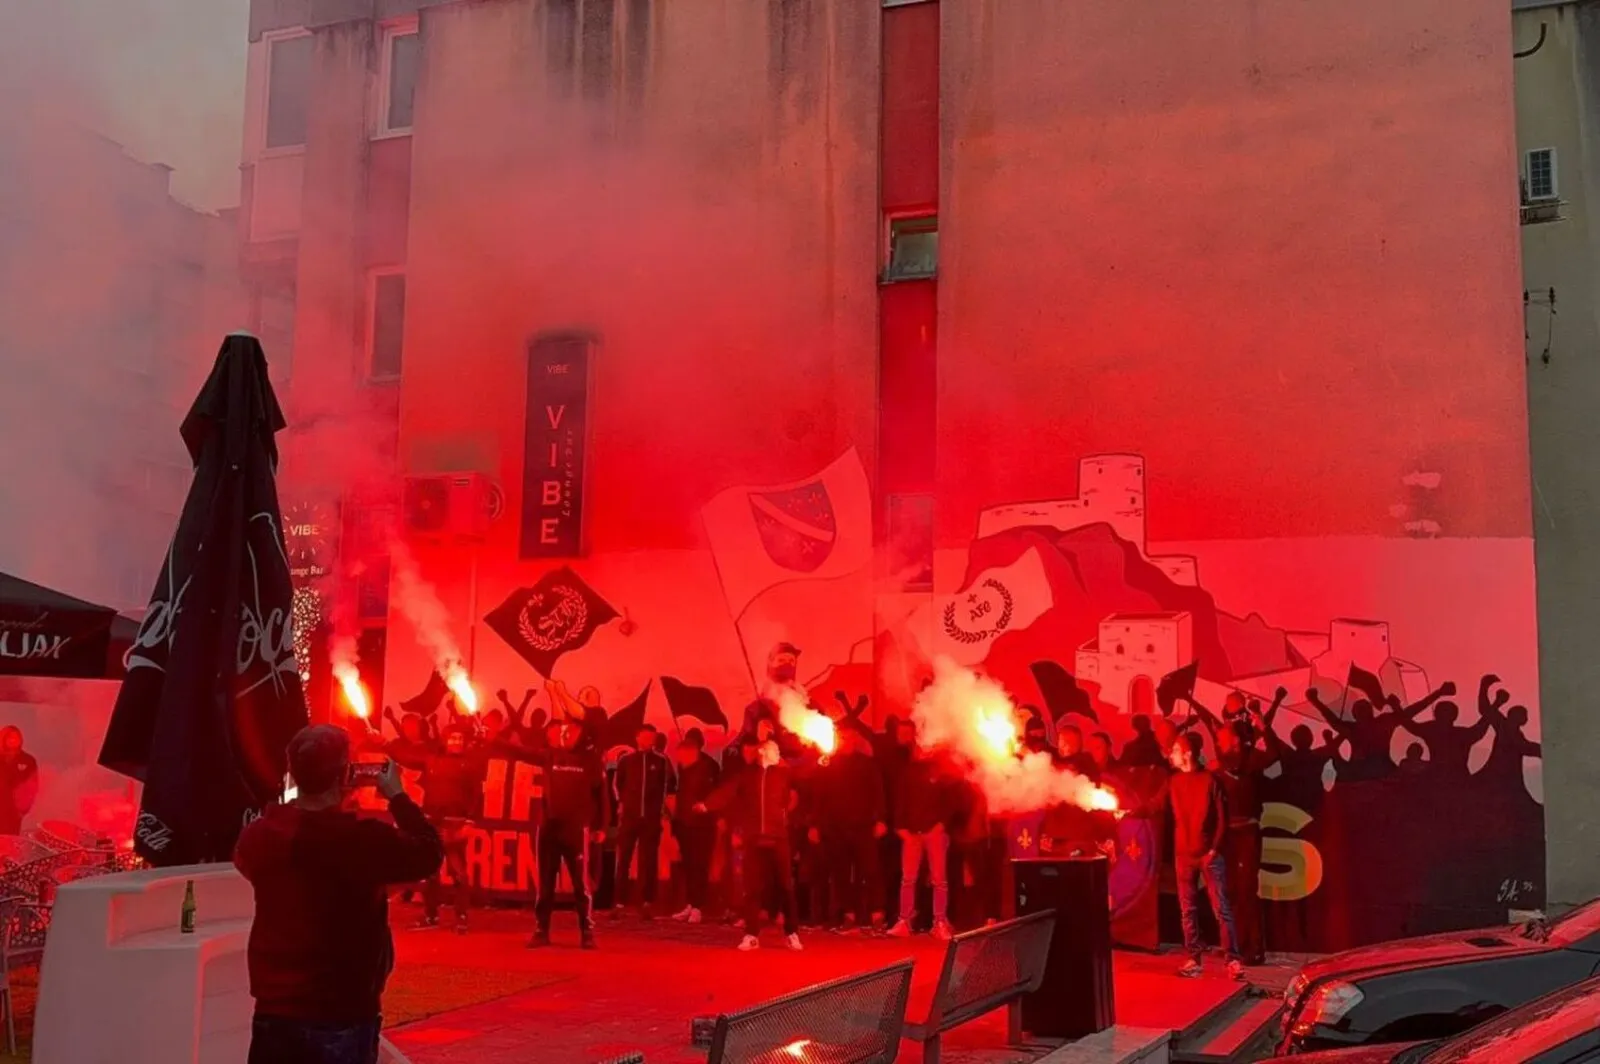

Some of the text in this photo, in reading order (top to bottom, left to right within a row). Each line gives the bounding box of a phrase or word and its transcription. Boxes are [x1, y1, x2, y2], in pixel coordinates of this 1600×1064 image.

[546, 364, 570, 375] VIBE
[540, 404, 565, 544] VIBE
[289, 524, 321, 537] VIBE
